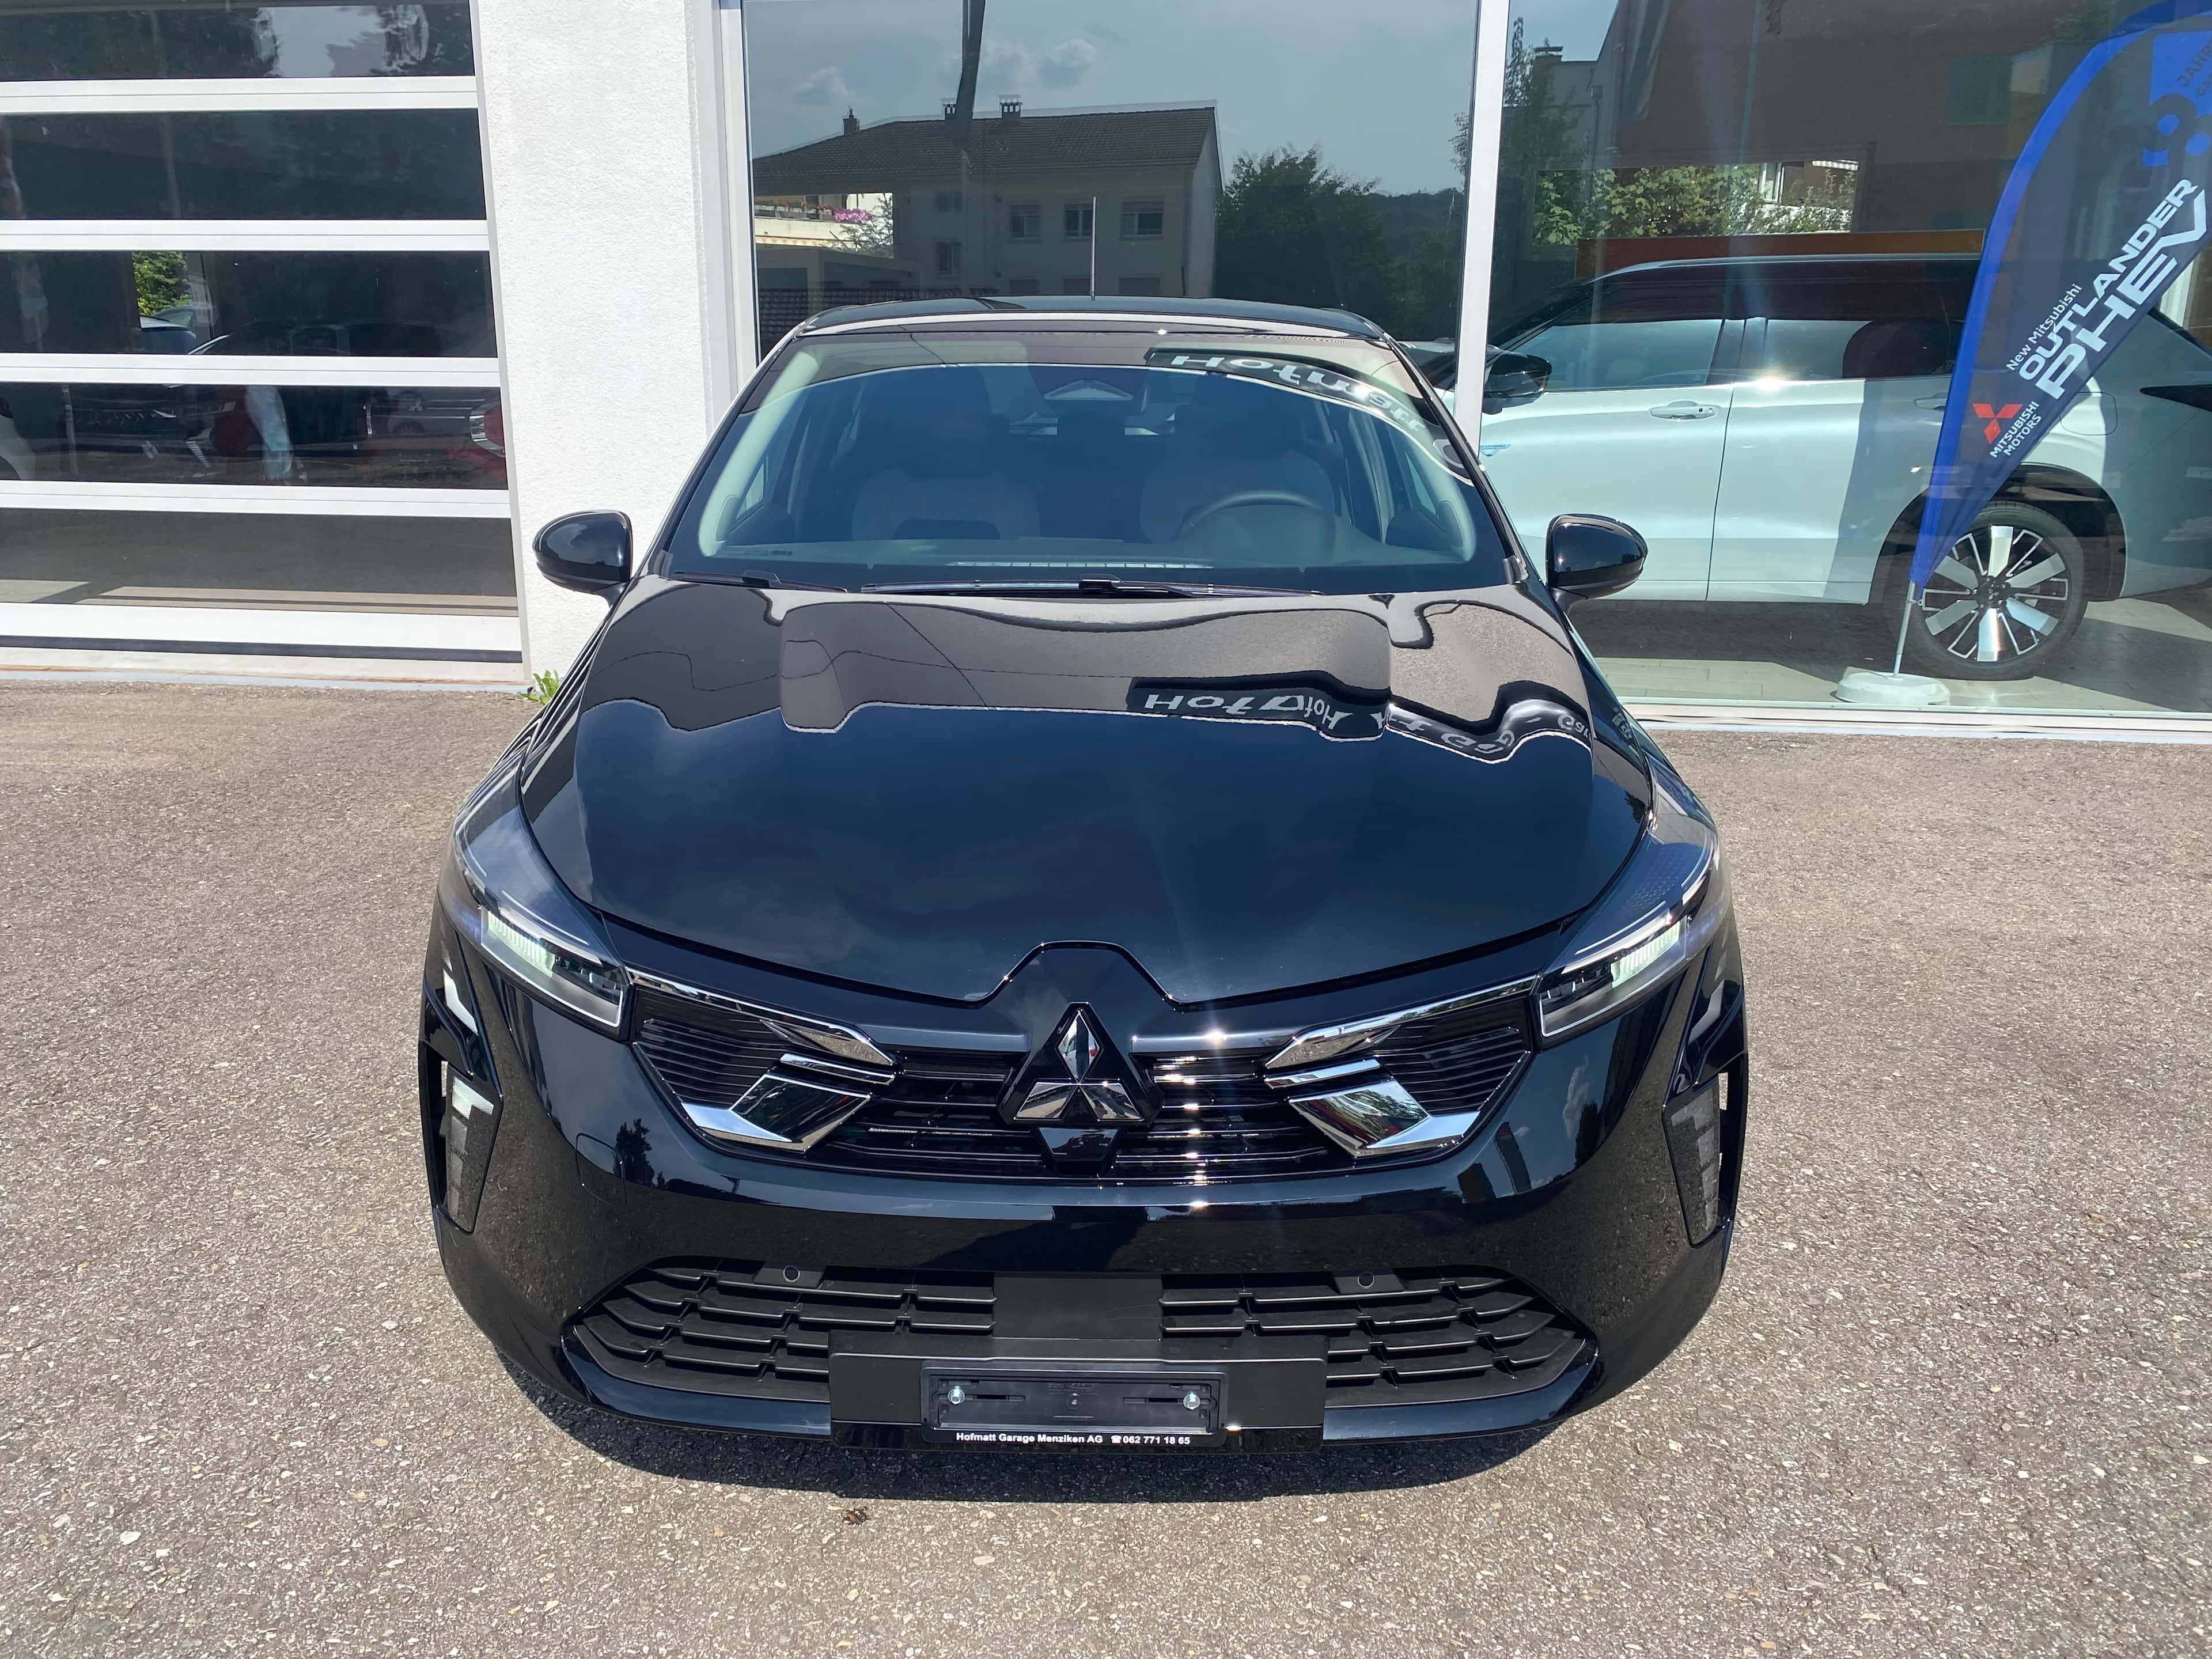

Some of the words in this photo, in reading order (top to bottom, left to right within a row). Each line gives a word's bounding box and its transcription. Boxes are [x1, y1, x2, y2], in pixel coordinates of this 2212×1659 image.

[2019, 179, 2198, 380] OUTLANDER
[2036, 189, 2207, 399] PHEV
[2006, 344, 2031, 370] New
[2028, 283, 2082, 344] Mitsubishi
[1990, 401, 2040, 458] MITSUBISHI
[2003, 414, 2041, 456] MOTORS
[956, 1432, 997, 1441] Hofmatt
[998, 1433, 1035, 1444] Garage
[1037, 1434, 1085, 1443] Menziken
[1087, 1435, 1103, 1443] AG
[1123, 1435, 1141, 1444] 062
[1143, 1435, 1160, 1444] 771
[1164, 1436, 1176, 1445] 18
[1178, 1437, 1191, 1445] 65
